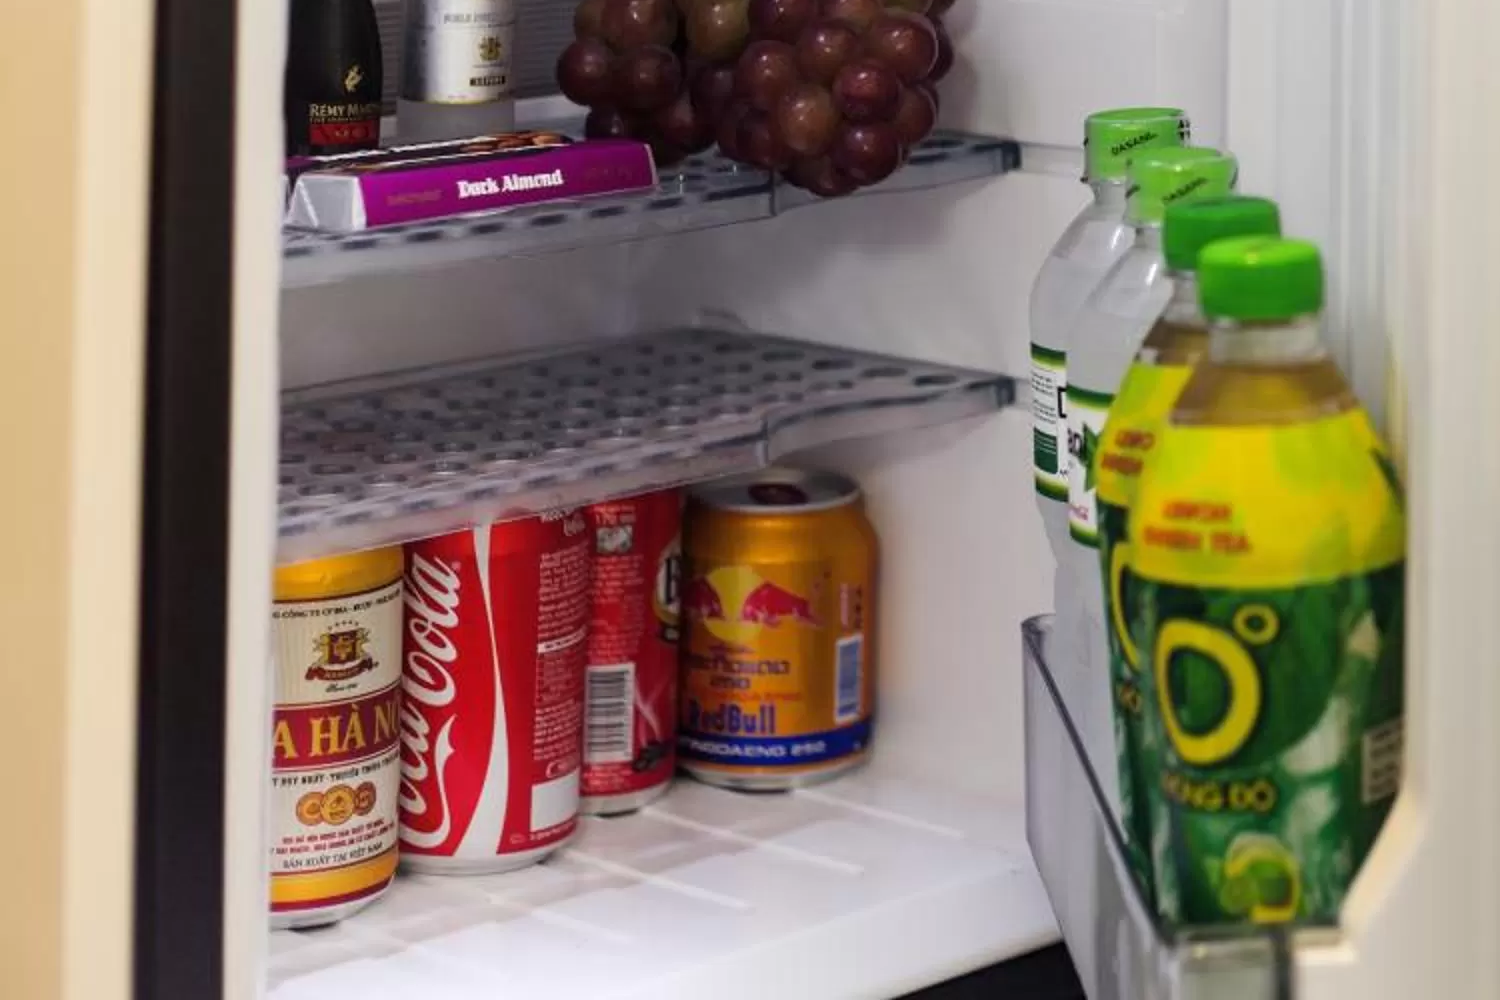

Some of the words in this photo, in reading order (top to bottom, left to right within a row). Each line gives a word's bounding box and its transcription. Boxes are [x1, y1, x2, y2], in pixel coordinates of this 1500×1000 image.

[457, 177, 500, 199] Dark
[502, 169, 563, 193] Almond
[309, 703, 366, 757] HÀ
